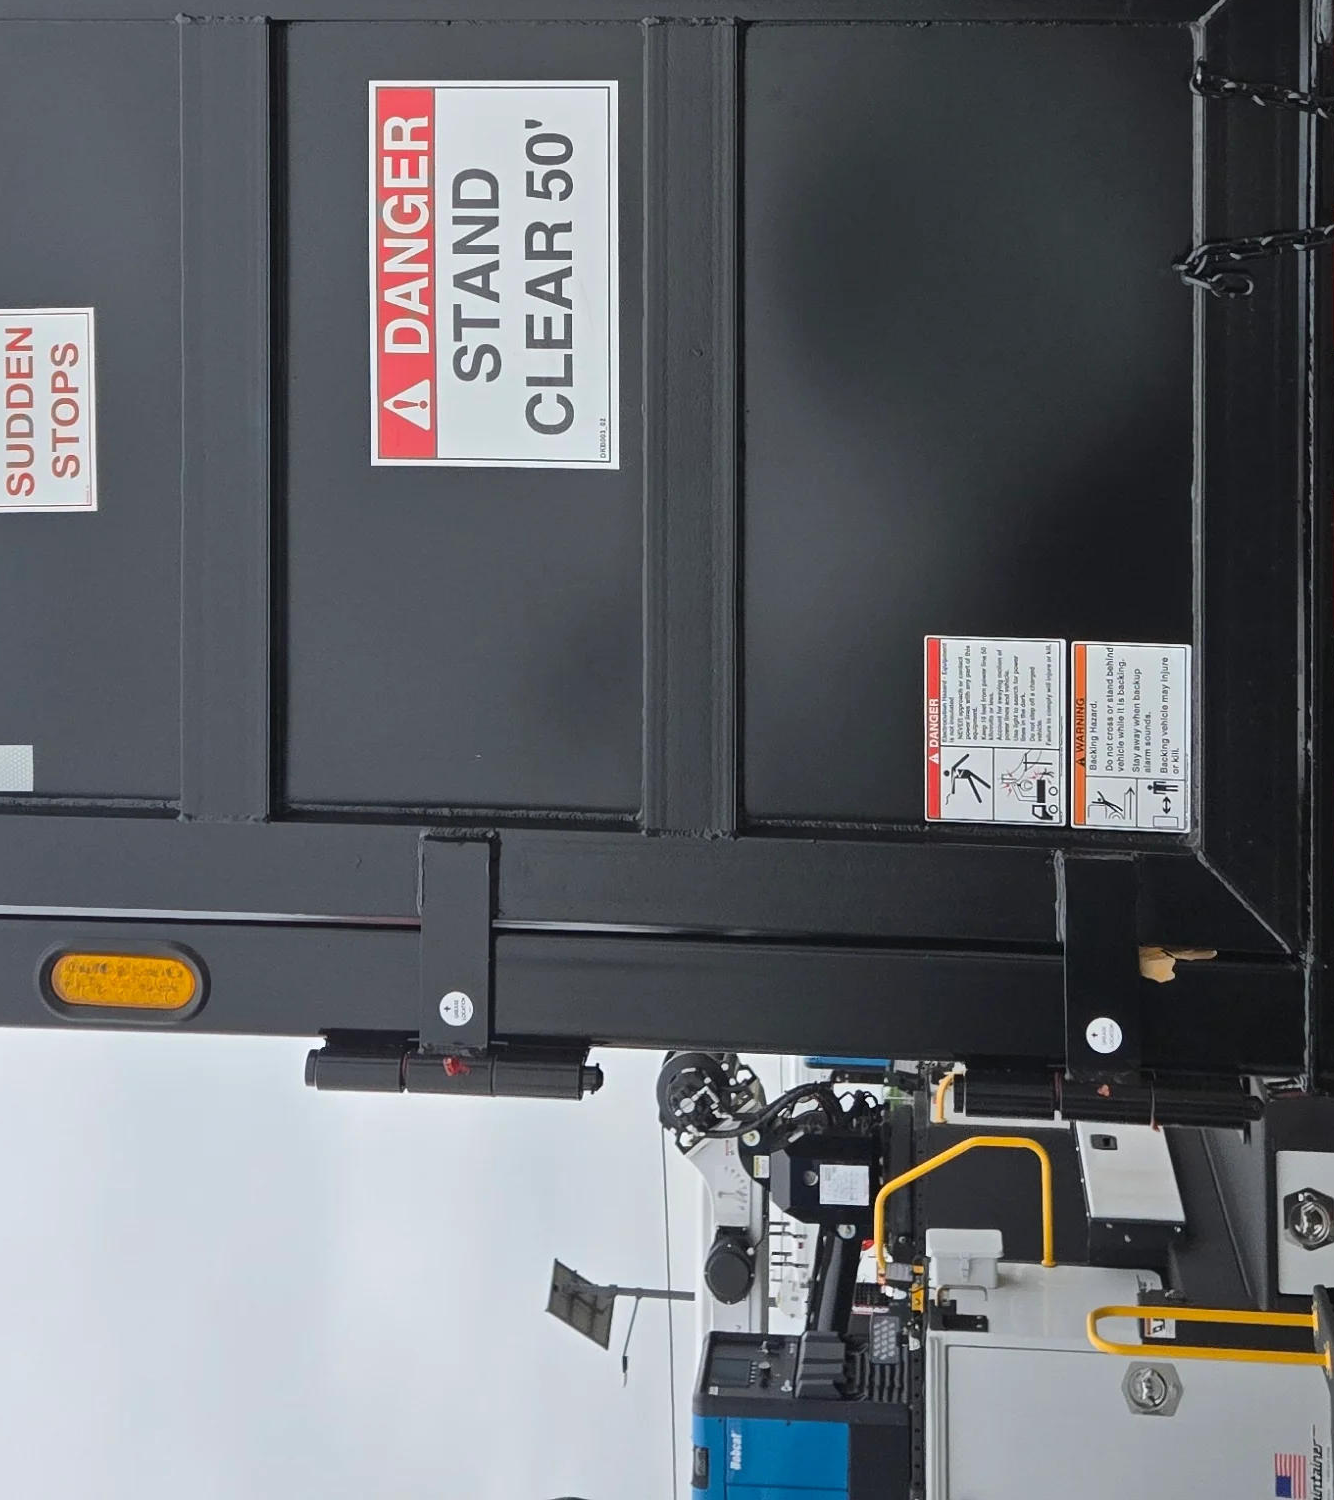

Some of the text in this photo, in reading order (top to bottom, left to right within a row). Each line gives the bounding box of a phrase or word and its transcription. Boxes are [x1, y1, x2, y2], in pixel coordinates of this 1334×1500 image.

[382, 116, 430, 354] DANGER
[452, 168, 501, 382] STAND
[525, 119, 575, 435] CLEAR 50'
[5, 327, 35, 496] SUDDEN
[50, 343, 80, 479] STOPS
[1117, 659, 1126, 695] backing.
[1133, 669, 1141, 700] backup
[929, 699, 939, 747] DANGER
[1076, 698, 1084, 753] WARNING
[1107, 705, 1113, 714] or
[1160, 658, 1170, 773] Backing vehicle may injure
[1089, 701, 1098, 770] Backing Hazard.
[1171, 748, 1179, 774] or kill.
[1106, 760, 1113, 771] Do
[1132, 753, 1141, 772] Stay
[730, 1433, 742, 1470] Bobcat
